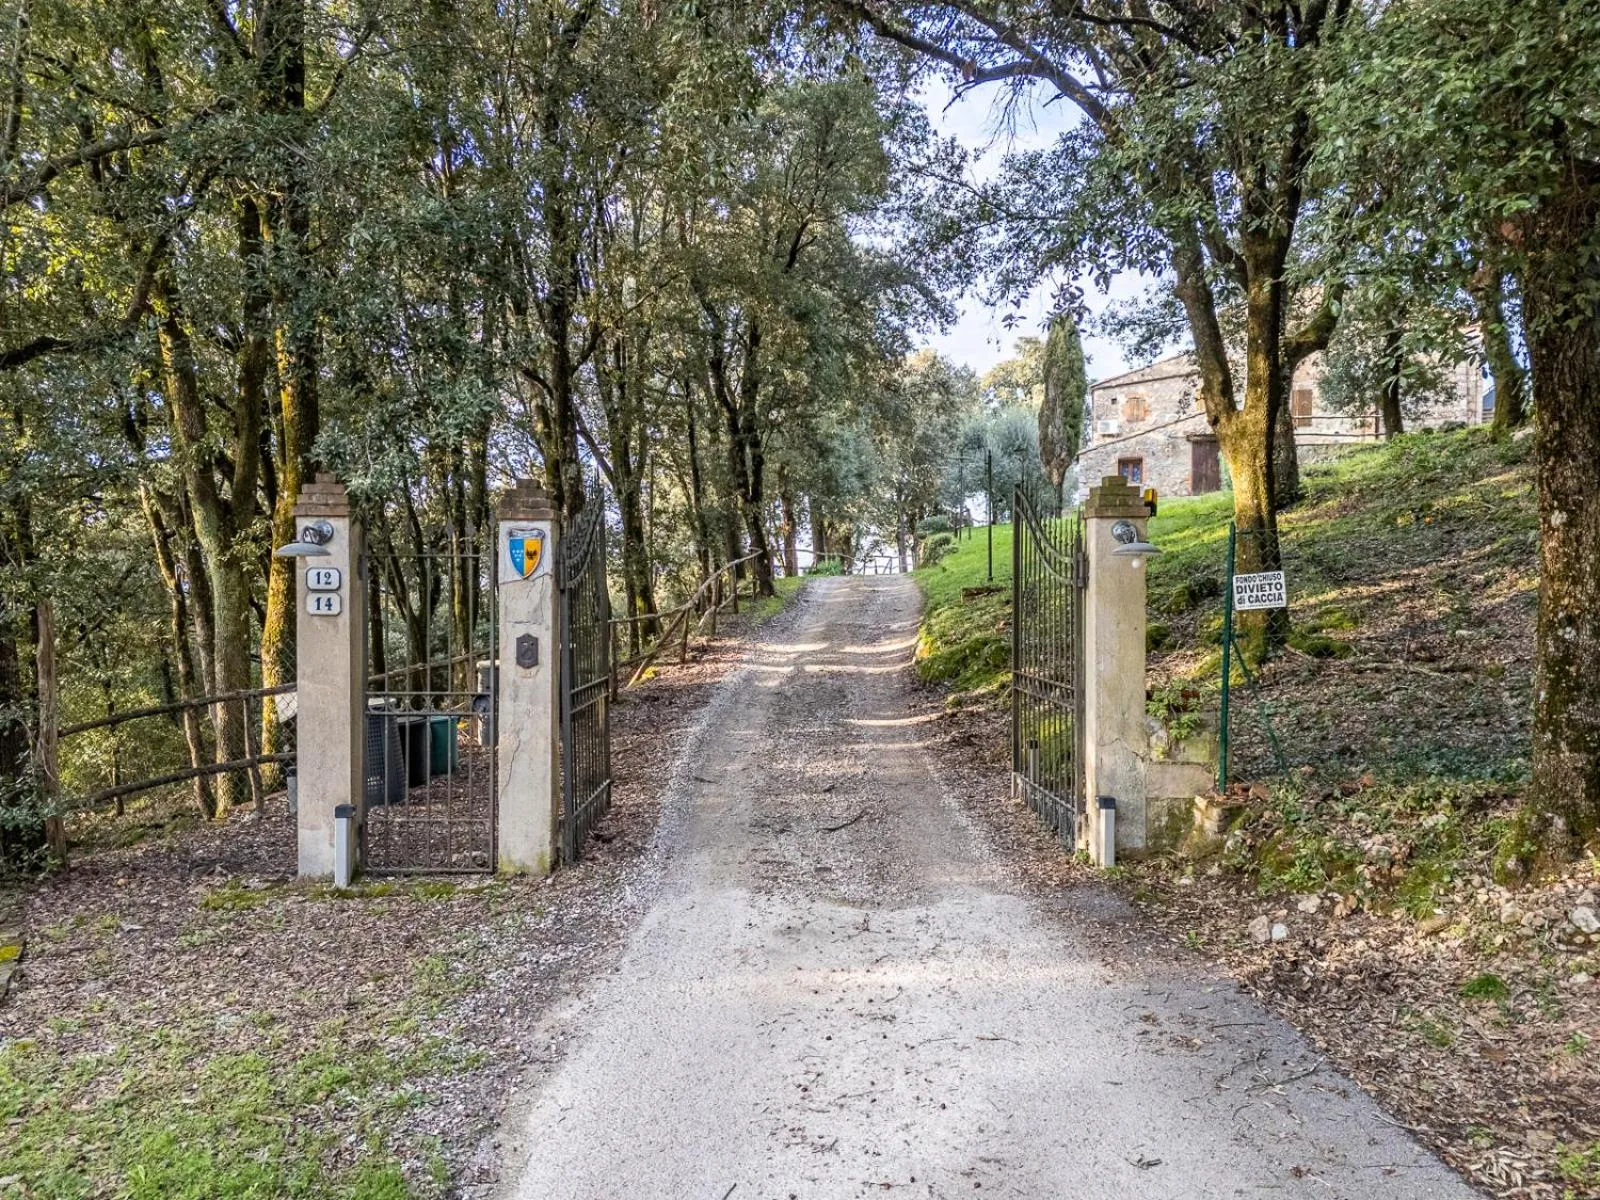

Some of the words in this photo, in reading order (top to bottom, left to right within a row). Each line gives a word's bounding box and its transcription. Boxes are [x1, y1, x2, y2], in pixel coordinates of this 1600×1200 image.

[316, 571, 332, 585] 12
[1236, 575, 1257, 584] FONDO
[1258, 573, 1281, 582] CHIUSO
[1236, 582, 1283, 594] DIVIETO
[315, 597, 332, 611] 14
[1237, 595, 1246, 604] di
[1248, 592, 1283, 603] CACCIA
